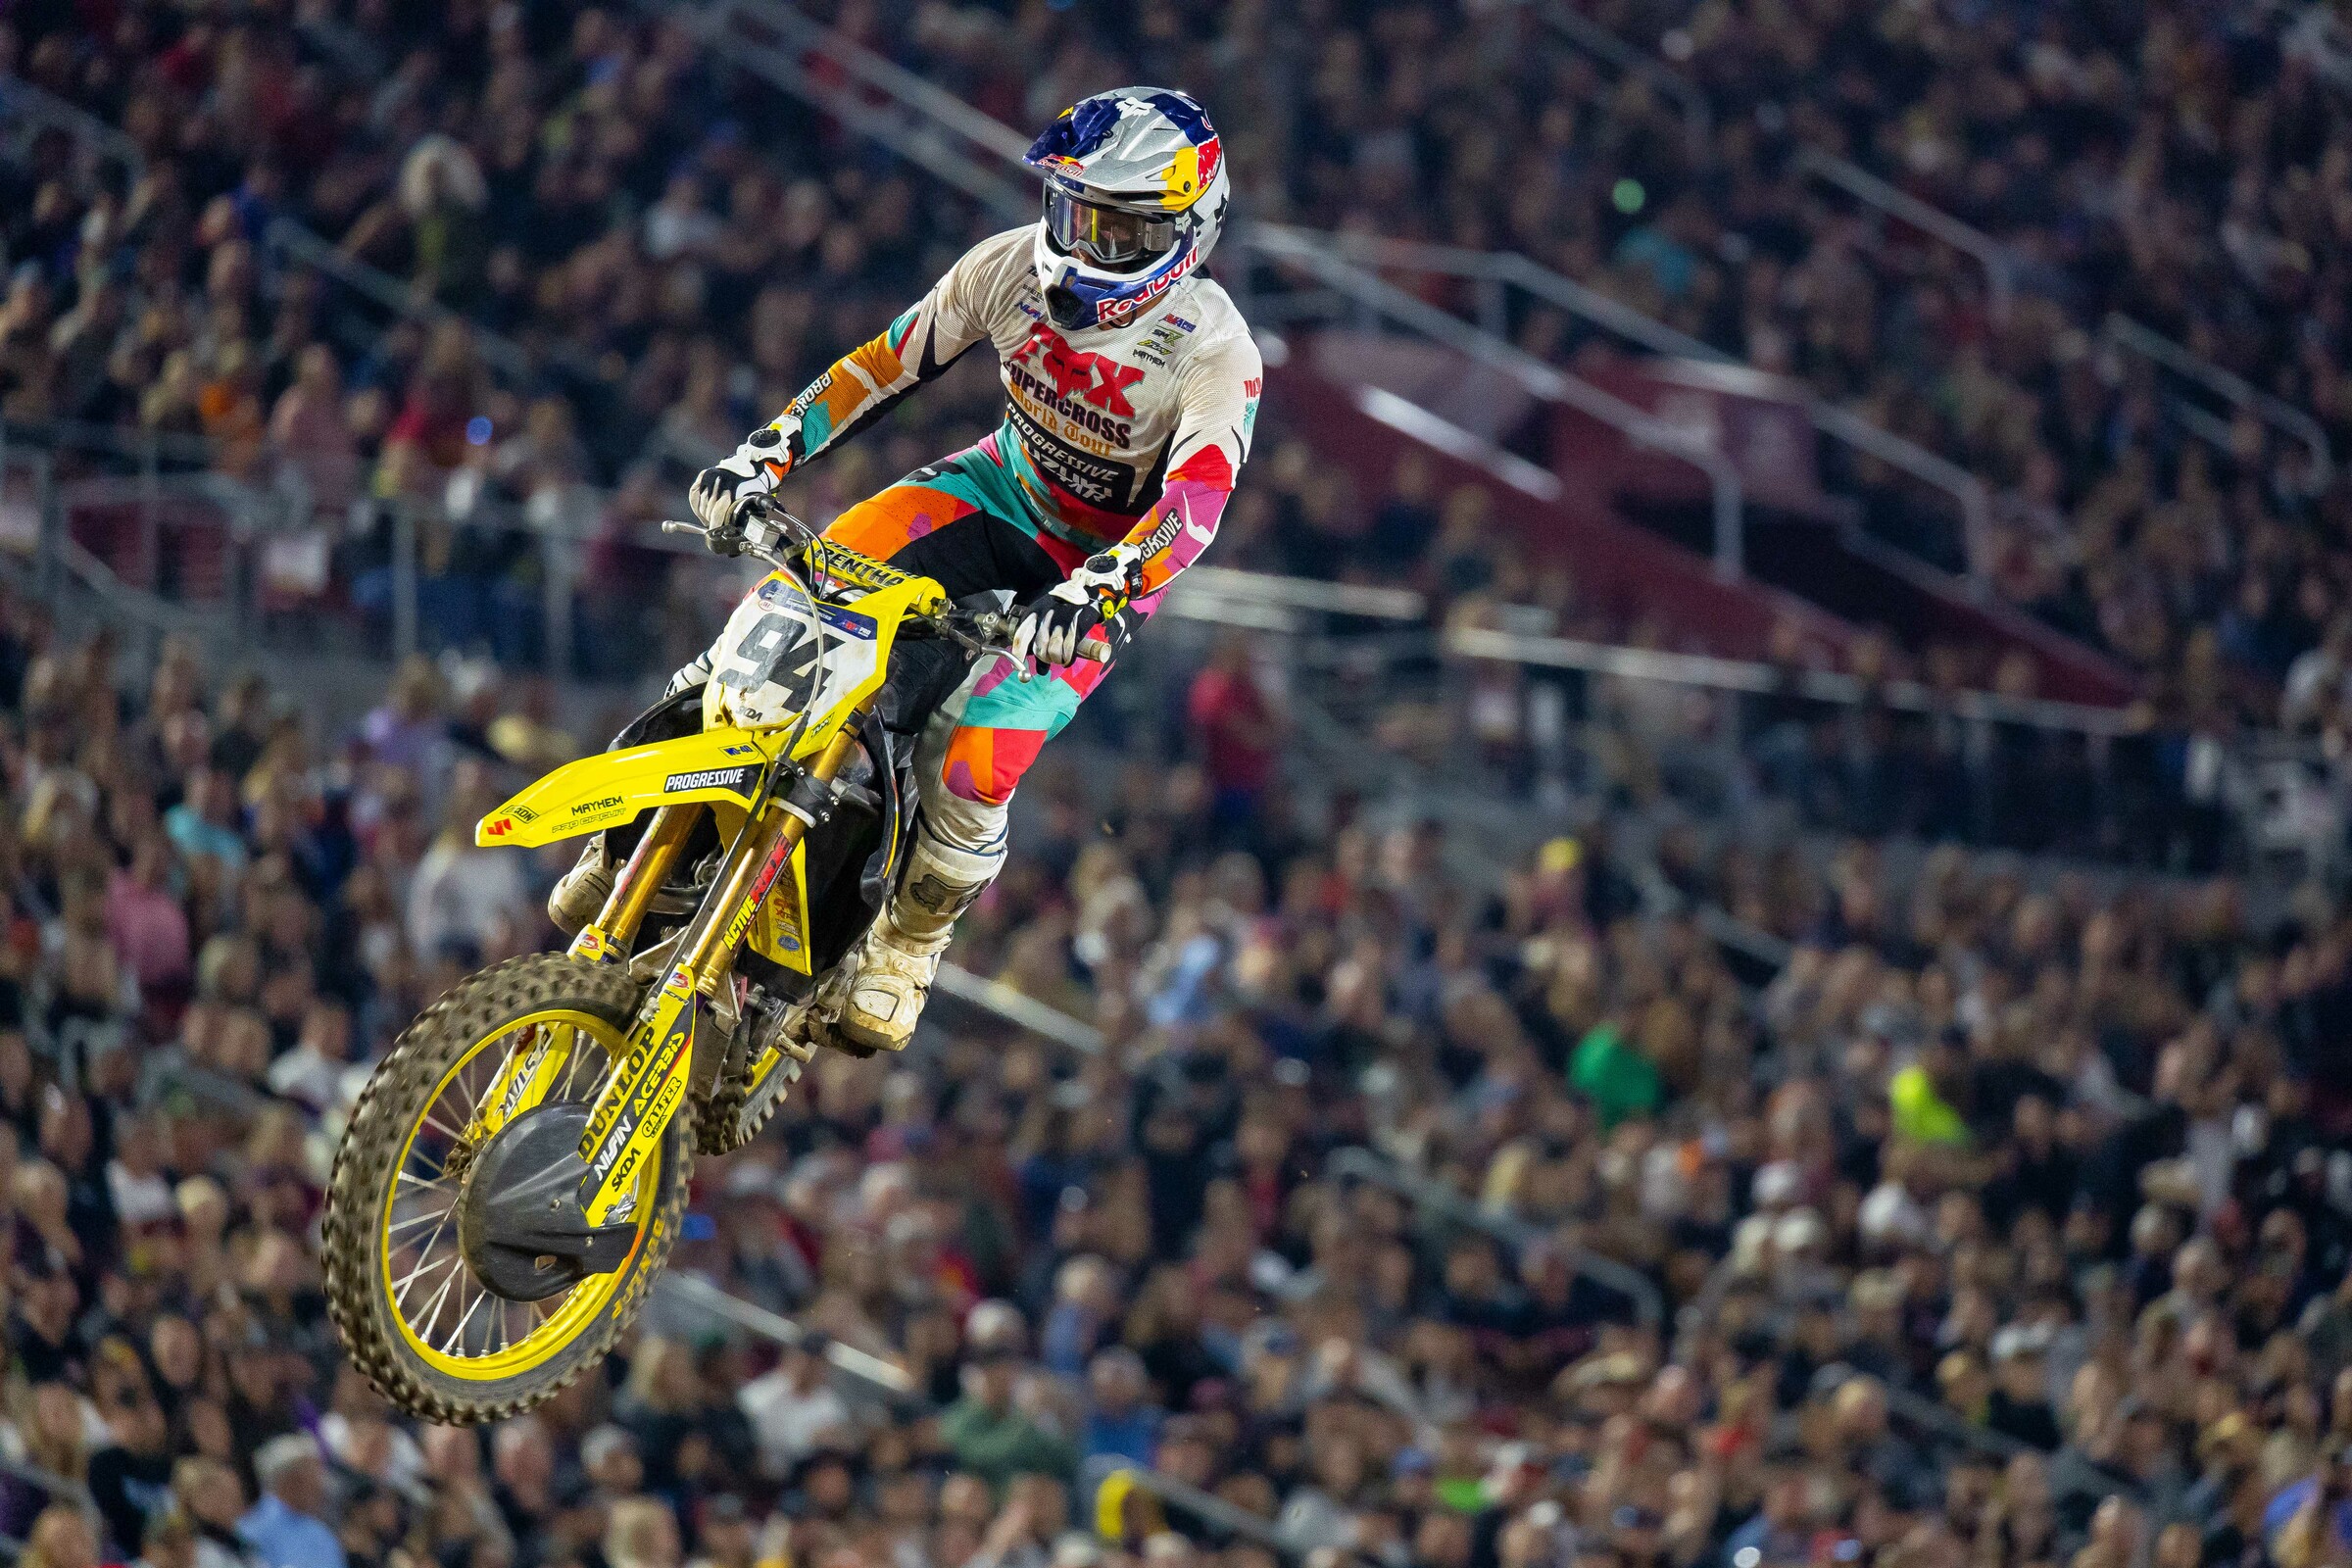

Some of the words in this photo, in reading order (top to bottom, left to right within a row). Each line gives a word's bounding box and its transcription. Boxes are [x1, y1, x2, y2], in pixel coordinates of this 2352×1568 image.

[1097, 283, 1152, 322] Red
[1148, 245, 1200, 295] Bull
[1132, 349, 1166, 368] MAYHEM
[1006, 402, 1119, 482] PROGRESSIVE
[1063, 420, 1116, 457] Tour
[814, 548, 906, 586] RENTHA
[716, 612, 847, 713] 94
[664, 768, 745, 791] PROGRESSIVE
[571, 796, 623, 816] MAYHEM
[578, 1027, 656, 1157] DUNLOP
[642, 1076, 682, 1138] GALFER
